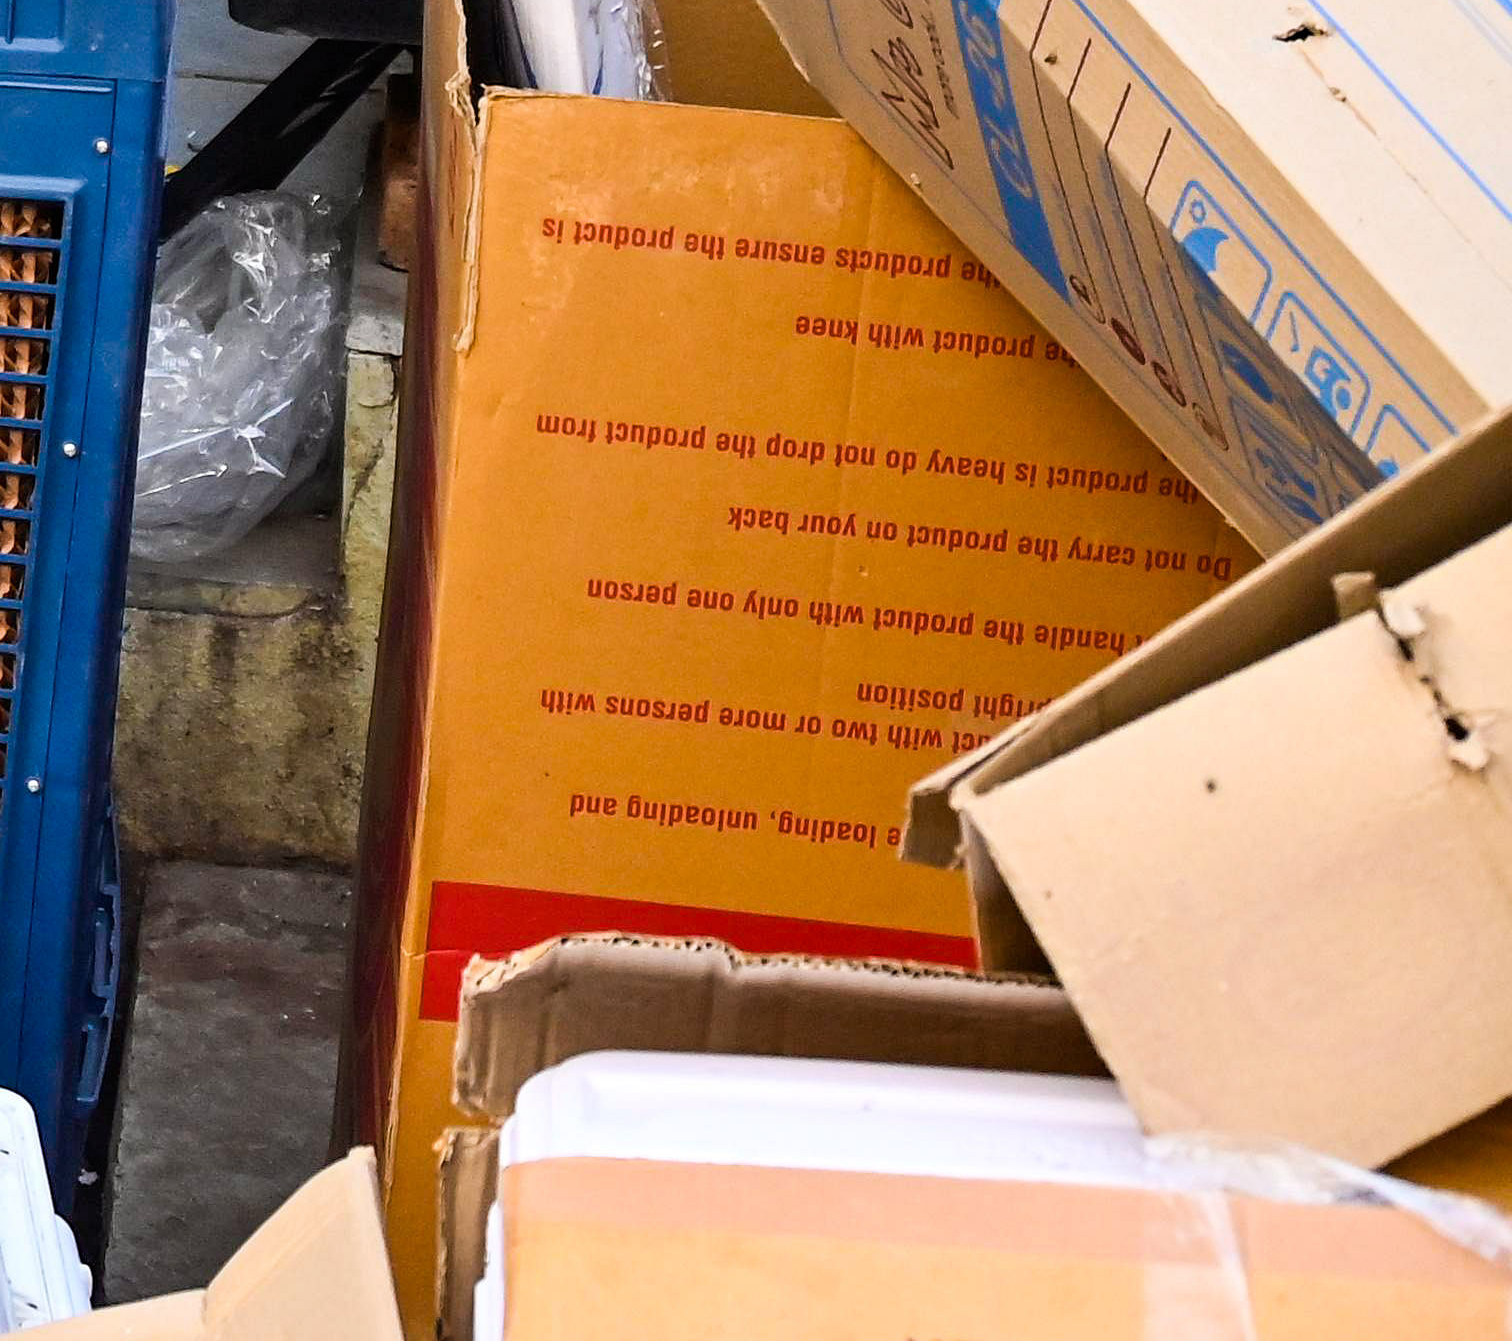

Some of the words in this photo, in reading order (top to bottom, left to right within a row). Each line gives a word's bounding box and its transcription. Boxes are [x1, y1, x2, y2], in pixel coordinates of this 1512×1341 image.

[543, 218, 563, 244] is
[574, 220, 674, 250] product
[684, 232, 725, 260] the
[734, 237, 826, 264] ensure
[836, 247, 952, 279] products
[795, 315, 859, 335] knee
[868, 320, 925, 350] with
[933, 329, 1036, 359] product
[536, 414, 596, 443] from
[606, 421, 706, 449] product
[716, 431, 755, 459] the
[766, 432, 825, 465] drop
[835, 443, 876, 467] not
[886, 448, 917, 474] do
[926, 449, 1004, 484] heavy
[1015, 461, 1036, 479] is
[1046, 465, 1149, 494] product
[727, 507, 790, 534] back
[797, 514, 857, 537] your
[866, 520, 898, 541] on
[907, 524, 1008, 552] product
[1018, 536, 1058, 562] the
[1068, 536, 1136, 566] carry
[1144, 549, 1186, 570] not
[1197, 555, 1232, 581] Do
[587, 578, 677, 605] person
[687, 588, 734, 611] one
[743, 589, 799, 619] only
[808, 601, 864, 627] with
[873, 608, 974, 637] product
[984, 619, 1024, 645] the
[1035, 623, 1126, 656] handle
[540, 689, 596, 715] with
[605, 693, 710, 724] persons
[857, 682, 964, 712] position
[719, 706, 786, 731] more
[795, 716, 822, 735] or
[831, 719, 878, 746] two
[887, 724, 943, 751] with
[570, 793, 617, 817] and
[626, 794, 758, 831] unloading
[770, 810, 876, 849] loading,
